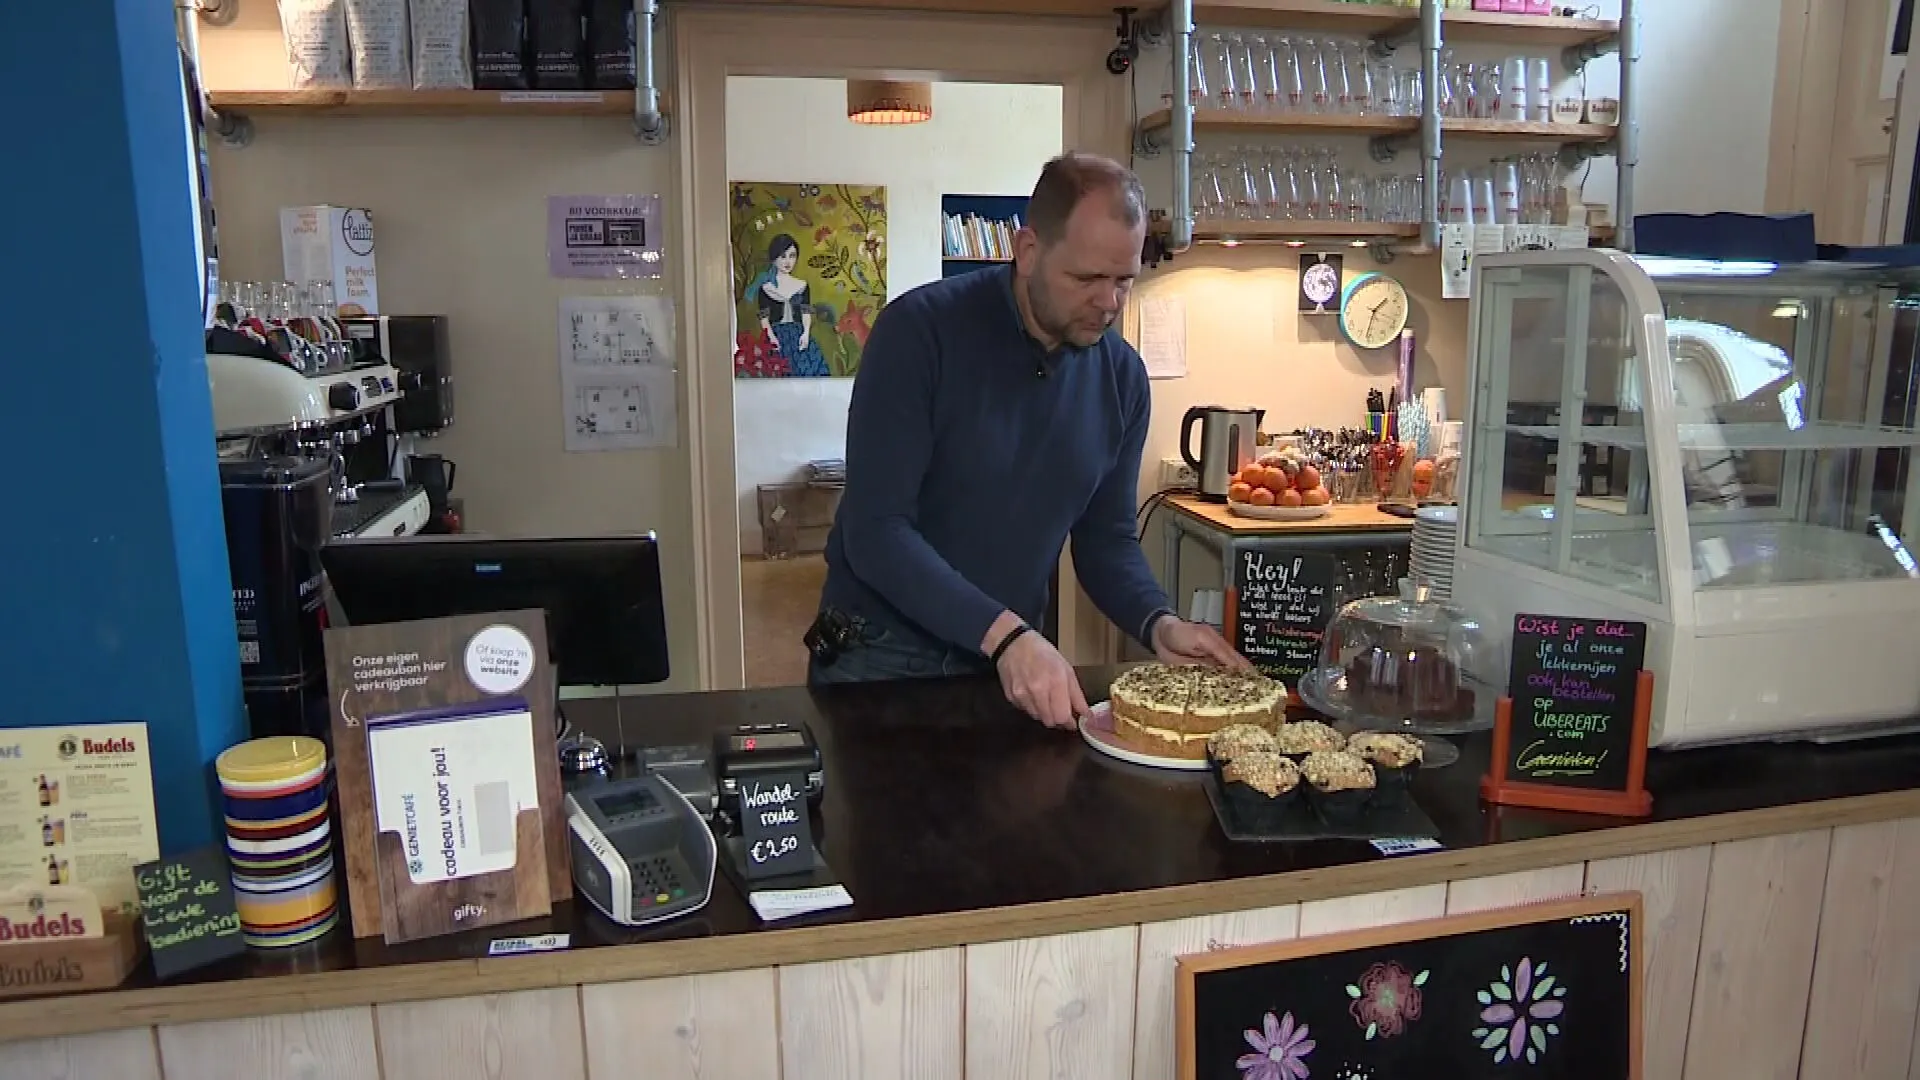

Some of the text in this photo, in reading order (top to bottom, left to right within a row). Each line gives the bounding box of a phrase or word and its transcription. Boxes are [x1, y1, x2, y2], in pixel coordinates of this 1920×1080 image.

[1244, 551, 1303, 590] Hey!
[1518, 618, 1559, 635] Wist
[1567, 624, 1584, 640] je
[1536, 640, 1552, 658] je
[1563, 640, 1579, 653] al
[352, 652, 419, 667] Onze eigen
[423, 661, 447, 671] hier
[496, 658, 519, 666] onze
[481, 665, 519, 676] website
[355, 676, 429, 692] verkrijgbaar
[1527, 673, 1554, 687] ook
[1534, 712, 1611, 732] UBEREATS
[83, 738, 136, 755] Budels
[742, 782, 800, 808] Wandel-
[430, 747, 458, 877] cadeau voor jou!
[760, 806, 799, 826] route
[193, 880, 219, 896] de
[149, 912, 240, 949] bediening
